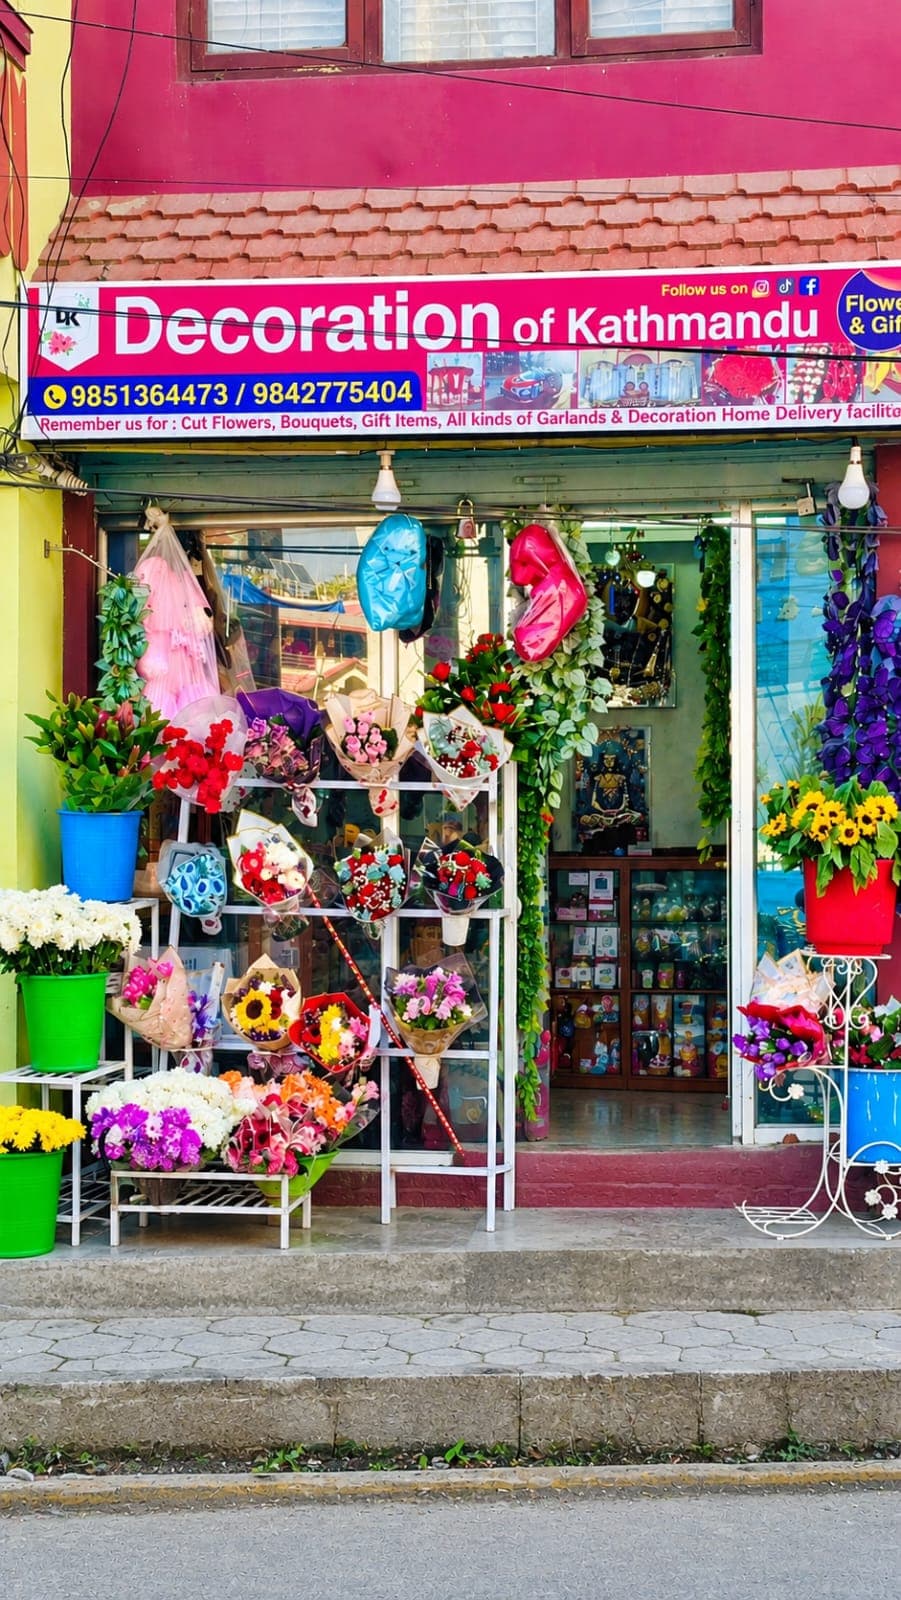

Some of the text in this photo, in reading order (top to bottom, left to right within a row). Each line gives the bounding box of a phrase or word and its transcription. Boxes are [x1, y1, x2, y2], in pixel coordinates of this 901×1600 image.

[661, 284, 748, 297] Follow us on
[115, 289, 819, 356] Decoration of Kathmandu
[849, 316, 866, 335] &
[71, 380, 413, 408] 9851364473 / 9842775404
[41, 417, 121, 432] Remember
[125, 420, 143, 431] us
[147, 416, 169, 431] for
[172, 419, 177, 430] :
[181, 416, 208, 430] Cut
[212, 415, 276, 431] Flowers,
[281, 414, 357, 431] Bouquets,
[361, 413, 391, 428] Gift
[396, 412, 442, 428] Items,
[446, 412, 466, 427] All
[471, 411, 512, 426] kinds
[516, 411, 532, 426] of
[537, 409, 607, 425] Garlands
[611, 410, 623, 424] &
[628, 408, 718, 424] Decoration
[722, 407, 771, 422] Home
[776, 404, 842, 423] Delivery
